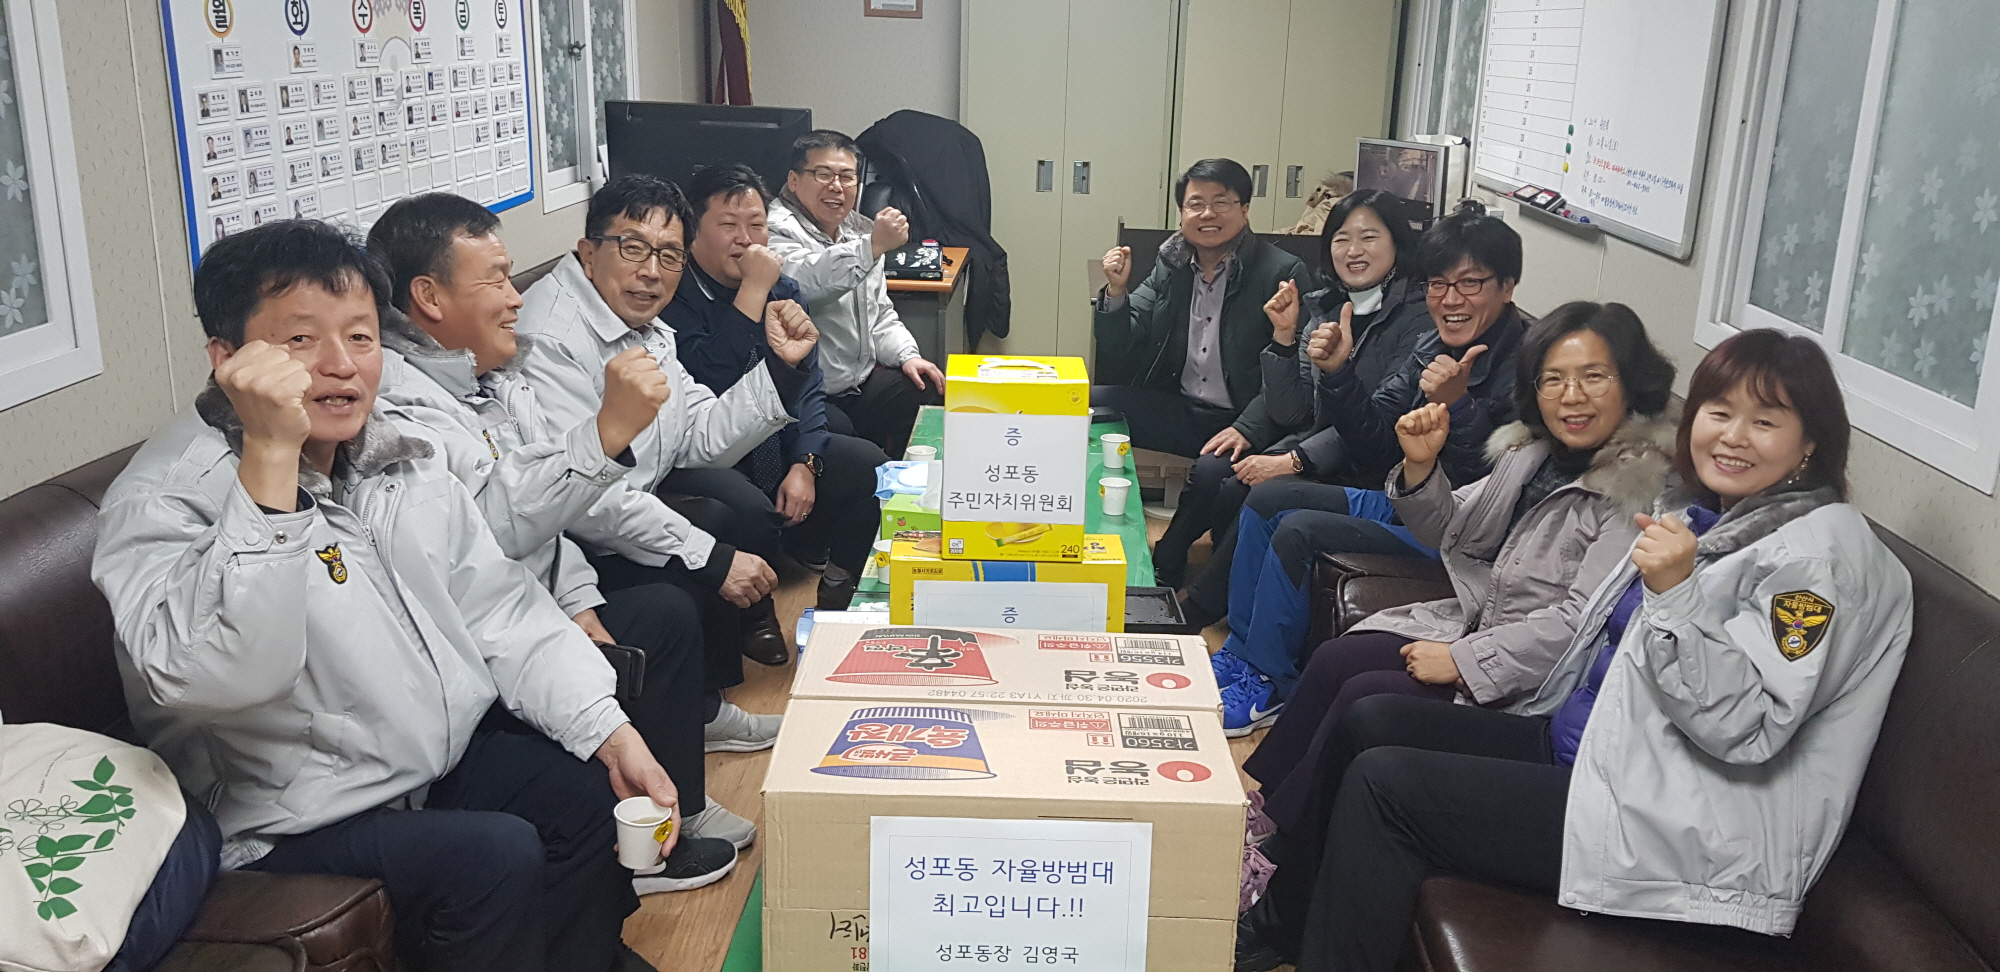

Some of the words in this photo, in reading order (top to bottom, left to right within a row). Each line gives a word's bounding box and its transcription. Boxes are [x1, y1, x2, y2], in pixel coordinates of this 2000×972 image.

[212, 0, 229, 29] 월
[290, 0, 304, 27] 화
[358, 0, 368, 25] 수
[413, 1, 422, 24] 목
[459, 2, 466, 23] 금
[498, 2, 505, 21] 토
[1004, 427, 1023, 446] 증
[984, 464, 1039, 483] 성포동
[947, 492, 1073, 512] 주민자치위원회
[1061, 544, 1080, 554] 240
[1001, 606, 1019, 624] 증
[1043, 641, 1092, 650] 취급주의
[1120, 655, 1182, 666] 가3556
[1064, 670, 1140, 685] 농심
[1065, 683, 1094, 691] 농심
[1096, 684, 1140, 692] 라면은
[927, 690, 966, 698] 04482
[971, 690, 1004, 699] 22:57
[1010, 691, 1041, 700] Y1A3
[1047, 692, 1073, 701] 까지
[1077, 693, 1148, 703] 2020.04.30
[1033, 710, 1068, 718] 마세요
[1071, 711, 1105, 719] 던지지
[1034, 719, 1089, 729] 취급주의
[847, 723, 969, 748] 육개장
[1125, 737, 1194, 750] 가3560
[1065, 760, 1150, 777] 농심
[1067, 776, 1099, 784] 농심
[1102, 777, 1150, 785] 라면은
[904, 856, 979, 880] 성포동
[991, 858, 1114, 884] 자율방범대
[932, 894, 1084, 920] 최고입니다.!!
[935, 944, 1012, 963] 성포동장
[1022, 945, 1080, 965] 김영국
